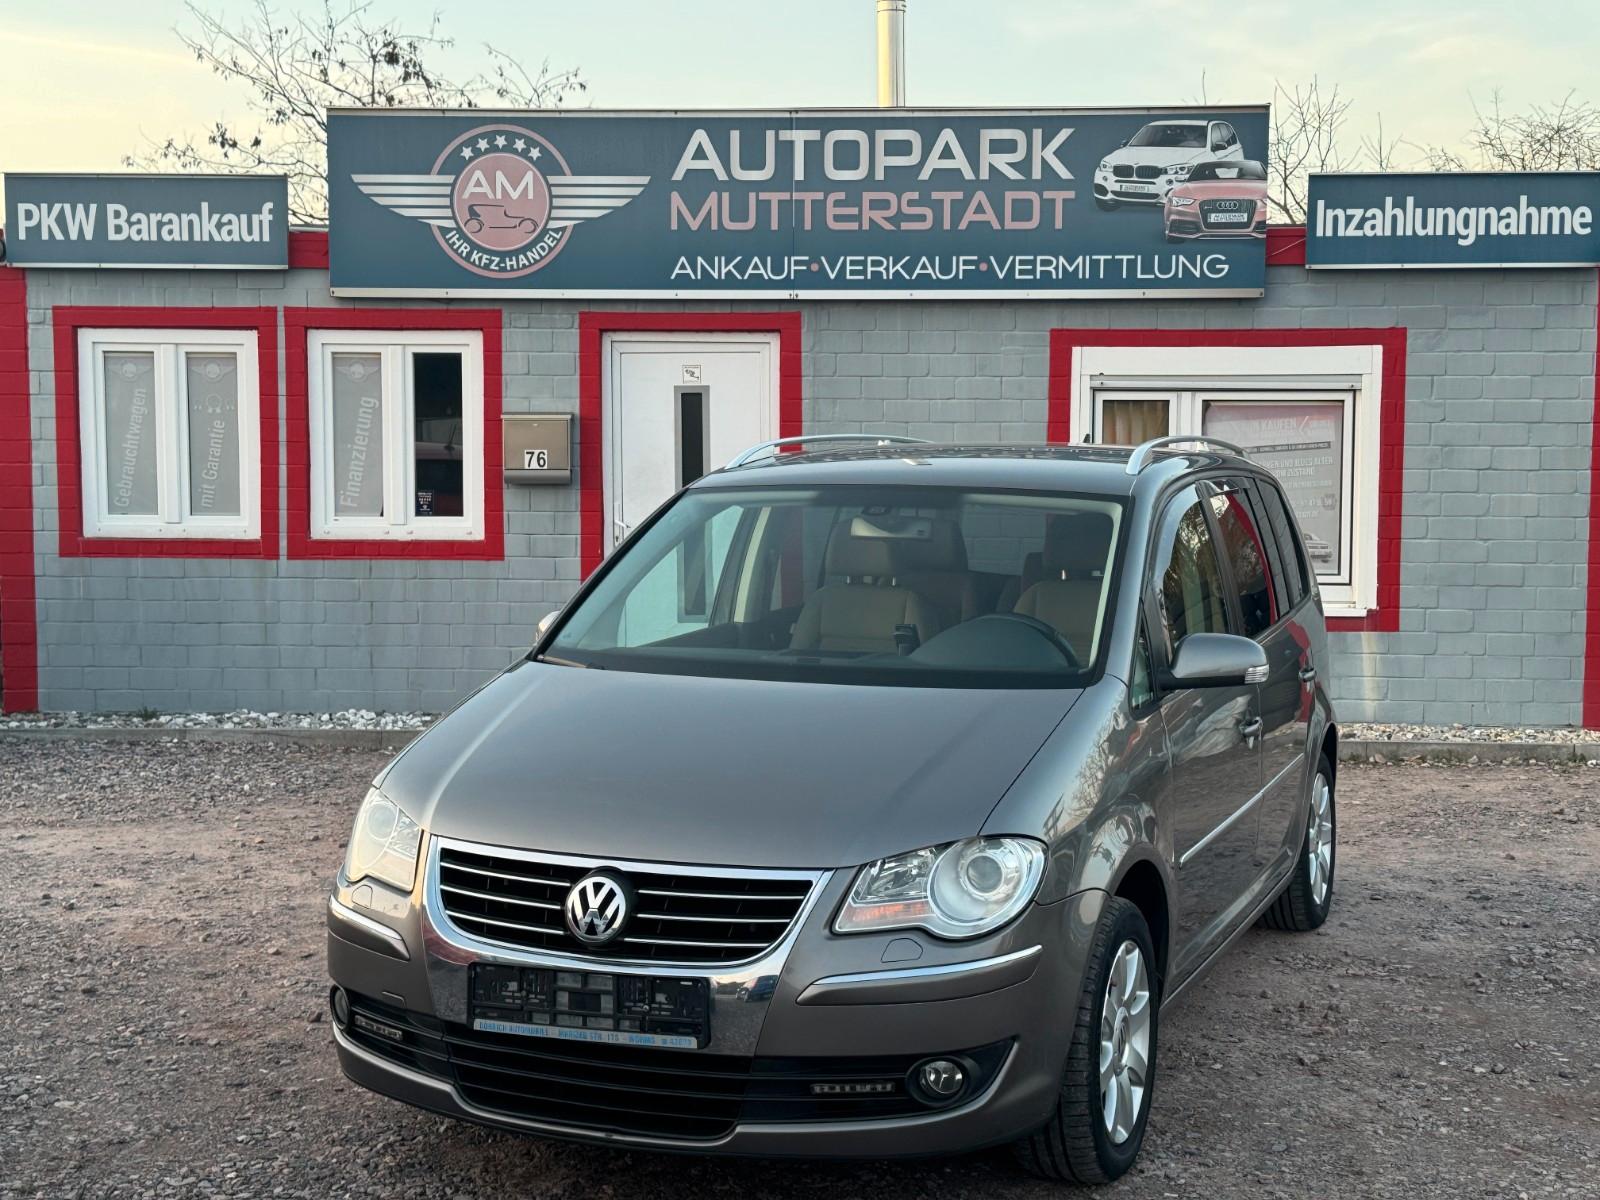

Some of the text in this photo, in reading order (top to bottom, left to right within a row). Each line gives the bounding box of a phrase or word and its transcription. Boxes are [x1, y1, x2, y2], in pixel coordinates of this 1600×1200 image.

[671, 127, 1075, 181] AUTOPARK
[462, 170, 535, 200] AM
[17, 201, 274, 243] PKW Barankauf
[670, 190, 1076, 231] MUTTERSTADT
[1316, 194, 1593, 247] Inzahlungnahme
[445, 228, 564, 271] IHR KFZ-HANDEL
[670, 254, 1230, 280] ANKAUF VERKAUF VERMITTLUNG
[113, 388, 148, 507] Gebrauchtwagen
[199, 420, 225, 508] mit Garantie
[340, 396, 379, 508] Finanzierung
[525, 451, 547, 468] 76
